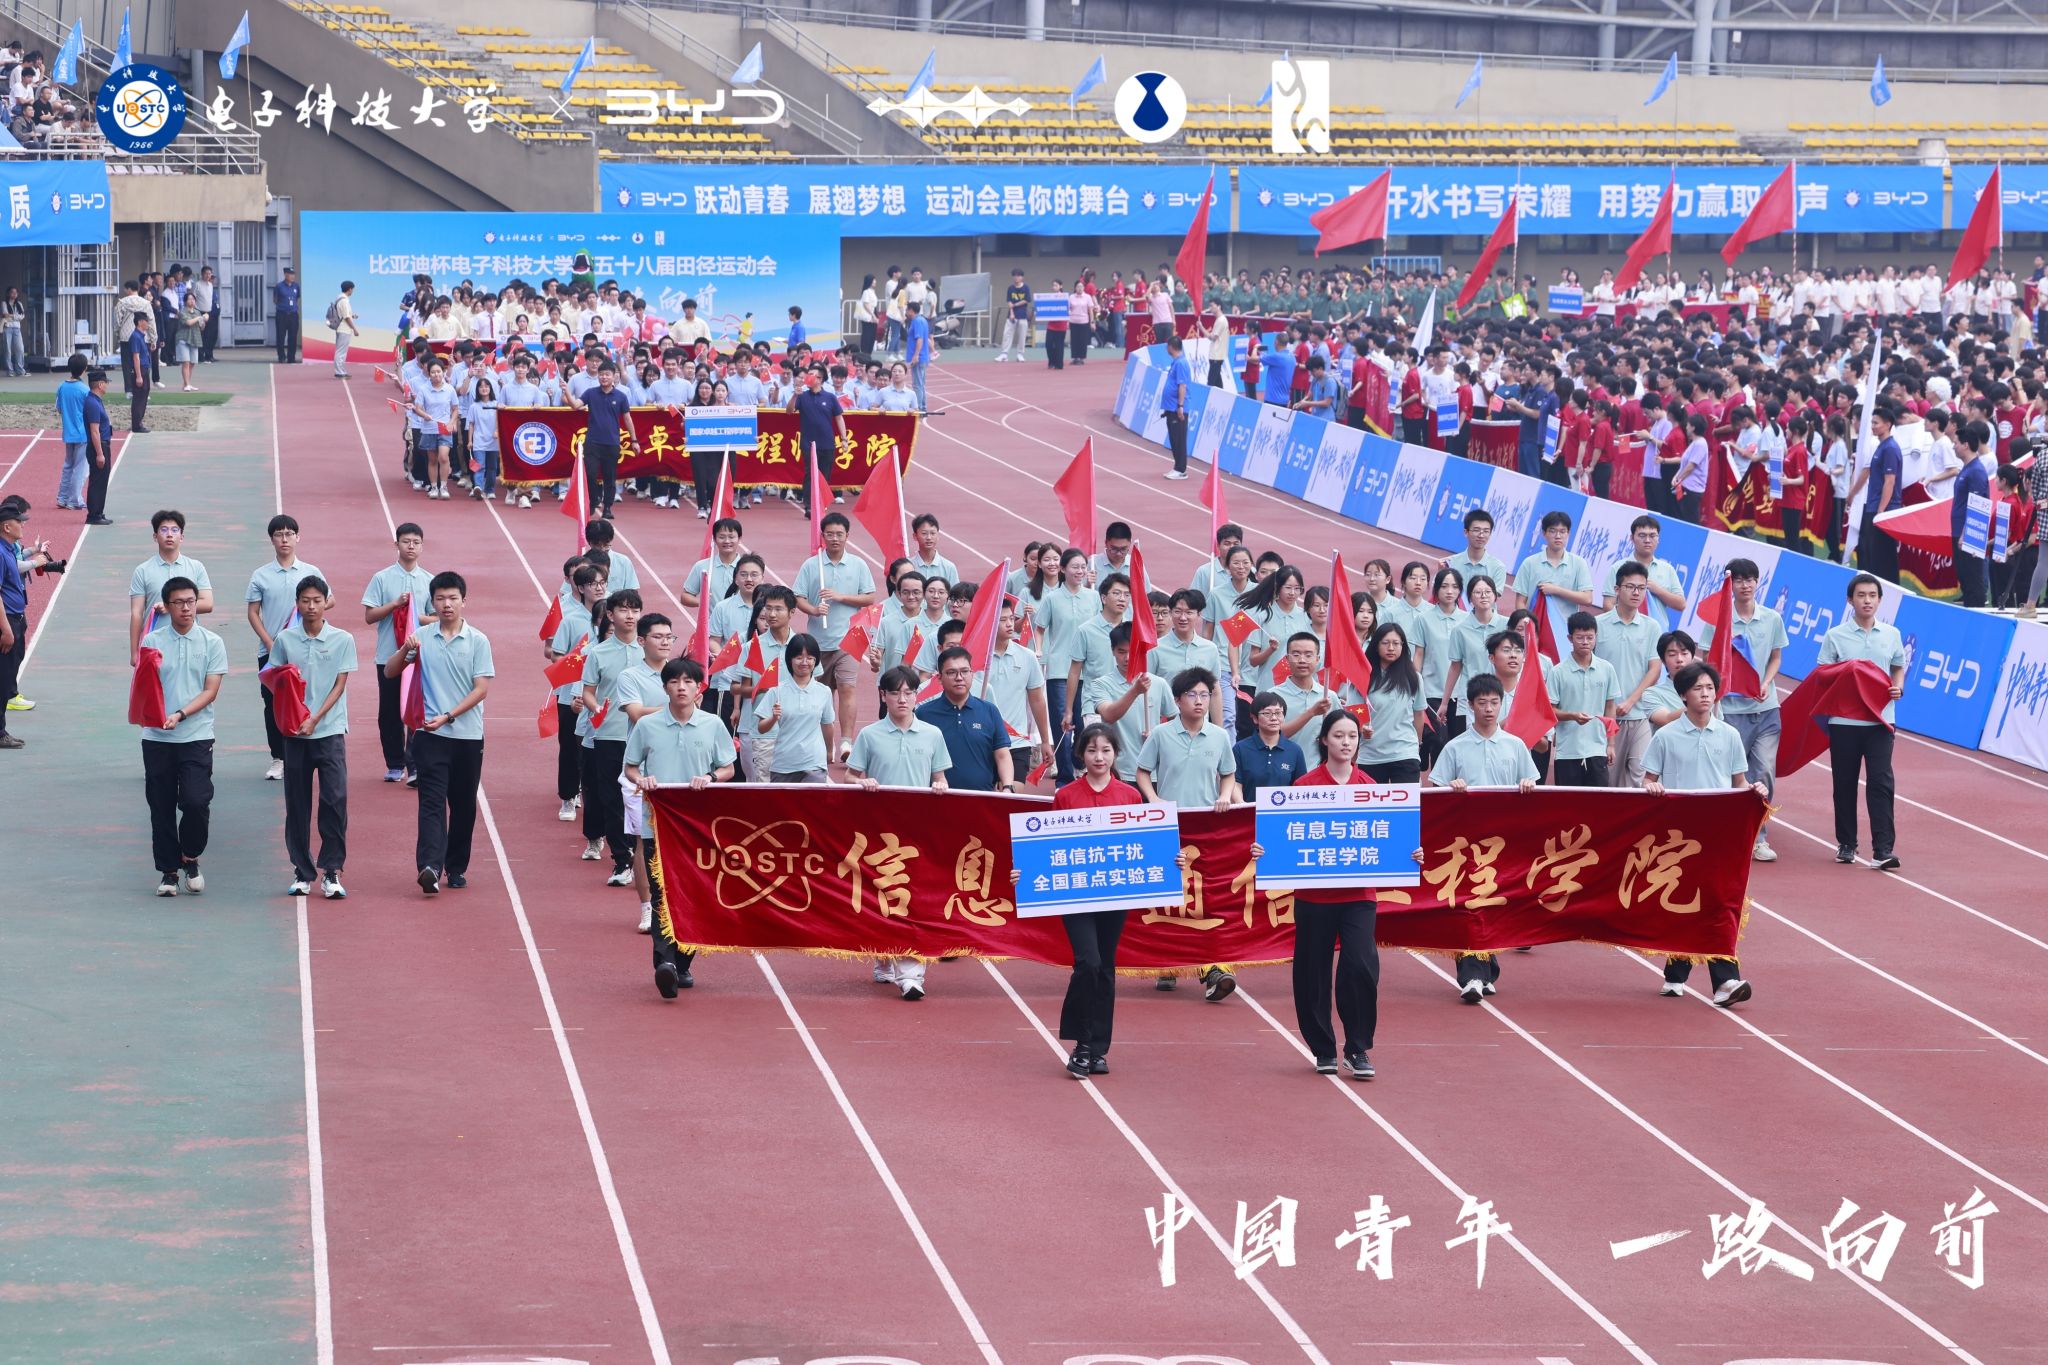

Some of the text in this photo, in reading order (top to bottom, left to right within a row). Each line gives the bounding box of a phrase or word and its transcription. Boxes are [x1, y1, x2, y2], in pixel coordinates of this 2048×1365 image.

[70, 193, 105, 209] BYD
[641, 184, 1218, 216] BYD 跃动青春 展翅梦想 运动会是你的舞台 BYD
[1283, 182, 1928, 219] BYD 汗水书写荣耀 用努力赢取声 BYD
[558, 234, 585, 242] BYD
[369, 254, 777, 277] 比亚迪杯电子科技大学五十八届田径运动会
[1363, 468, 1389, 497] BYD
[1788, 600, 1833, 643] BYD
[1919, 651, 1980, 699] BYD
[1288, 790, 1337, 801] 电子科技大学
[1354, 790, 1408, 802] BYD
[1043, 813, 1092, 826] 电子科技大学
[1110, 809, 1165, 824] BYD
[1286, 819, 1390, 841] 信息与通信
[1050, 843, 1144, 867] 通信抗干扰
[1296, 846, 1379, 867] 工程学院
[1033, 865, 1165, 892] 全国重点实验室
